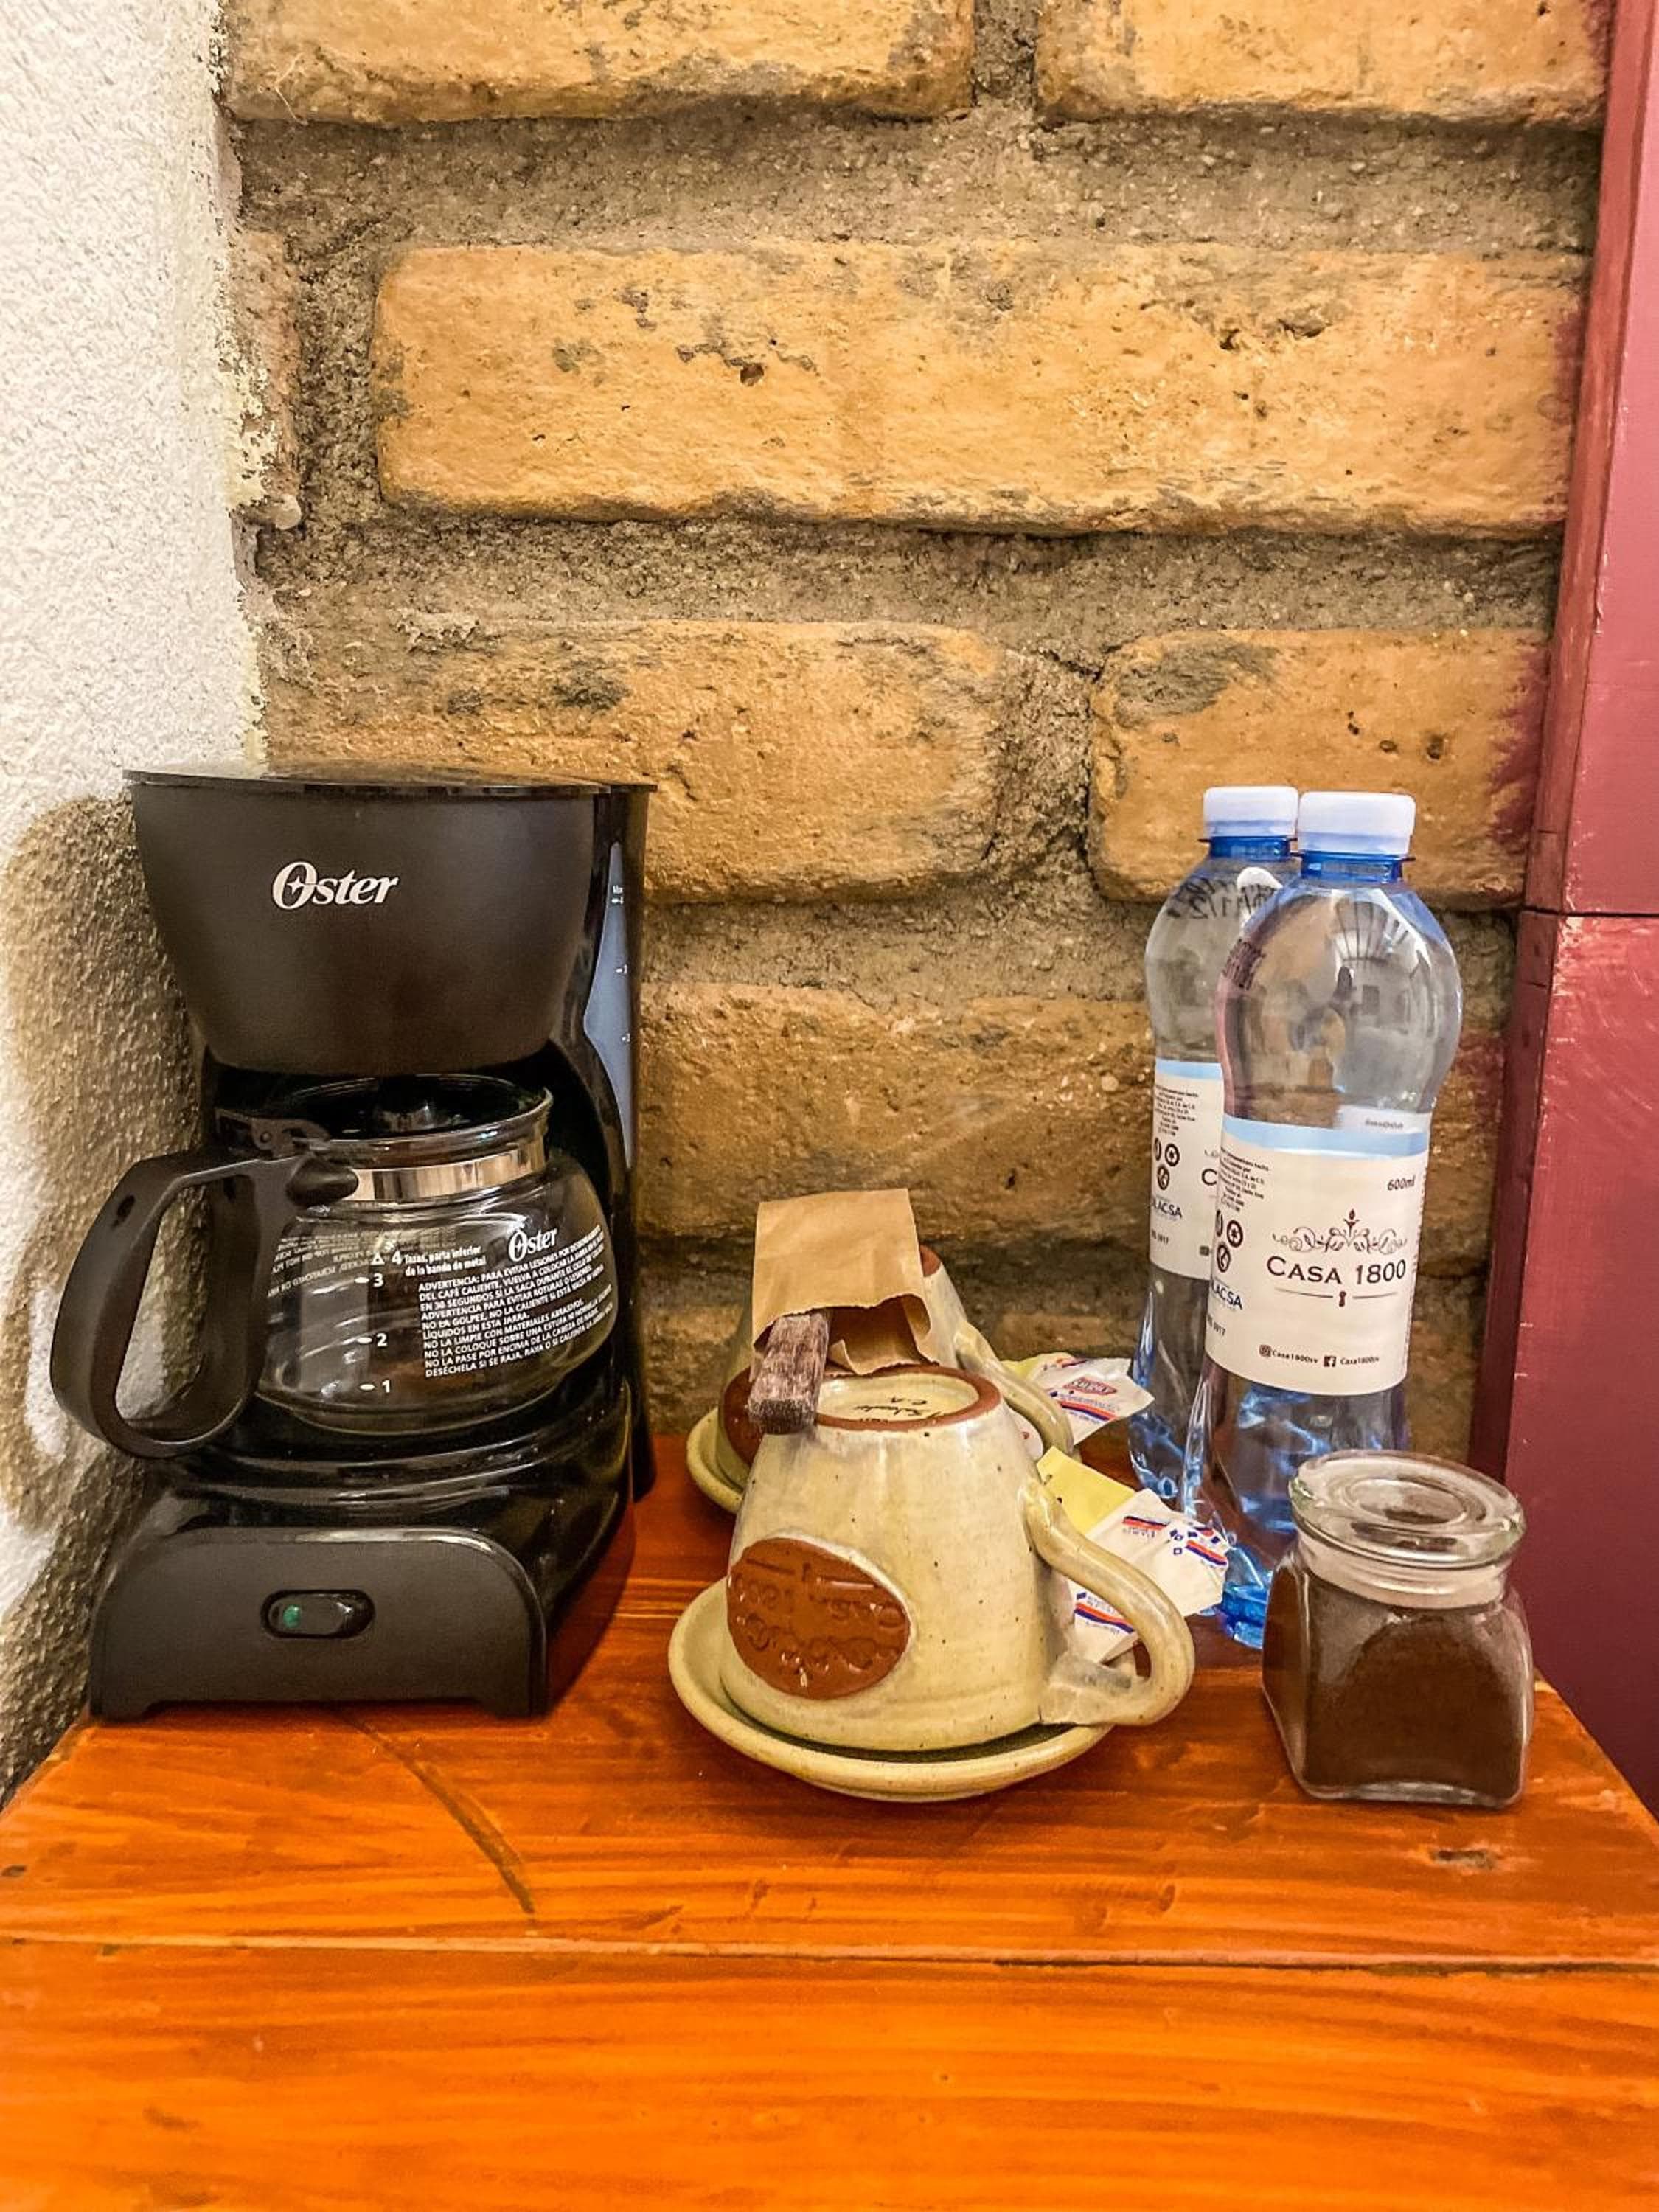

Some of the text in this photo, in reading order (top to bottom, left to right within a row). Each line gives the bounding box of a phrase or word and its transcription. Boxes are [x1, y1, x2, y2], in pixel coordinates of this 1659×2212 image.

[272, 860, 400, 910] Oster
[1387, 1175, 1416, 1191] 600ml
[392, 1251, 403, 1265] 4
[464, 1255, 487, 1268] metal
[508, 1228, 558, 1262] Oster
[373, 1273, 384, 1287] 3
[418, 1276, 480, 1292] ADVERTENCIA:
[481, 1270, 503, 1282] PARA
[504, 1263, 529, 1276] EVITAR
[529, 1252, 558, 1267] LESIONES
[420, 1292, 437, 1302] DEL
[502, 1271, 531, 1287] VUELVA
[532, 1270, 539, 1279] A
[538, 1259, 567, 1276] COLOCAR
[1266, 1256, 1406, 1285] CASA 1800
[420, 1303, 433, 1312] EN
[447, 1292, 494, 1307] SEGUNDOS
[504, 1287, 515, 1297] LA
[536, 1268, 566, 1286] DURANTE
[421, 1304, 482, 1321] ADVERTENCIA
[483, 1298, 506, 1311] PARA
[507, 1291, 532, 1305] EVITAR
[533, 1279, 563, 1297] ROTURAS
[422, 1321, 437, 1330] NO
[489, 1309, 503, 1319] NO
[504, 1305, 515, 1315] LA
[515, 1295, 549, 1312] CALIENTE
[468, 1324, 480, 1332] EN
[481, 1319, 502, 1331] ESTA
[504, 1312, 530, 1325] JARRA.
[377, 1332, 388, 1347] 2
[423, 1340, 439, 1349] NO
[440, 1338, 452, 1347] LA
[454, 1332, 482, 1345] LIMPIE
[484, 1328, 503, 1339] CON
[504, 1314, 549, 1334] MATERIALES
[424, 1350, 439, 1359] NO
[441, 1347, 453, 1357] LA
[455, 1339, 497, 1354] COLOQUE
[498, 1332, 524, 1345] SOBRE
[526, 1326, 543, 1337] UNA
[425, 1359, 439, 1368] NO
[442, 1357, 453, 1366] LA
[455, 1352, 477, 1363] PASE
[479, 1349, 497, 1358] POR
[498, 1340, 529, 1354] ENCIMA
[531, 1335, 541, 1346] DE
[542, 1332, 552, 1341] LA
[425, 1363, 477, 1377] DESÉCHELA
[489, 1357, 499, 1366] SE
[500, 1352, 524, 1363] RAJA,
[524, 1344, 543, 1356] RAYA
[382, 1380, 390, 1393] 1
